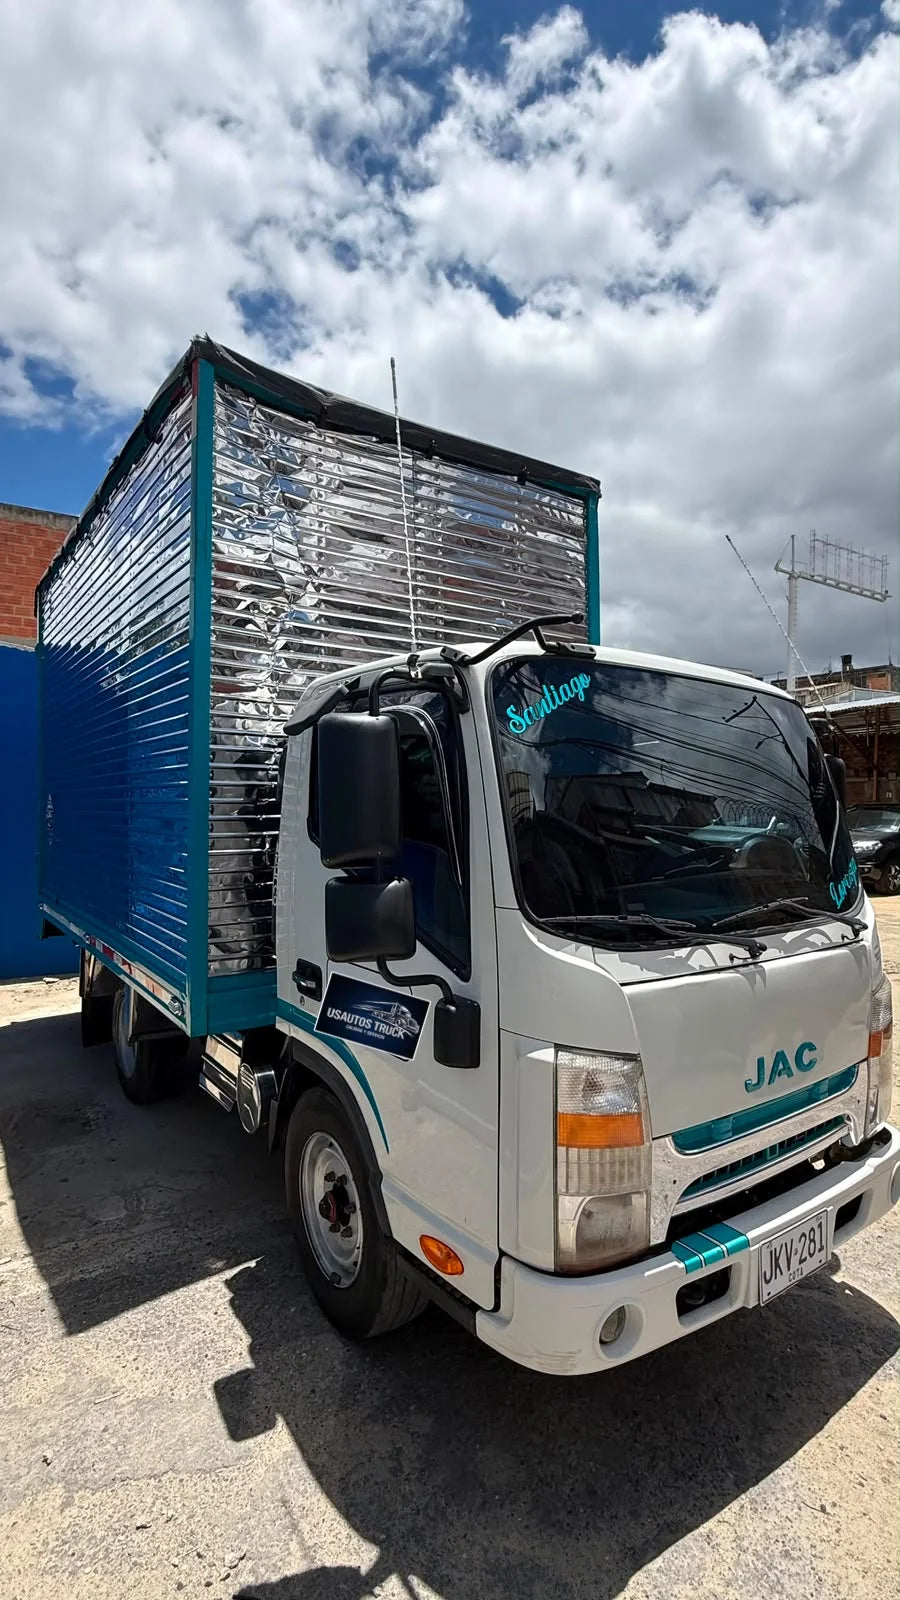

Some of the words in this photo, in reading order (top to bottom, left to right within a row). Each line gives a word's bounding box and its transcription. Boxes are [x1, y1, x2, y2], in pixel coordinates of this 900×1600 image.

[506, 672, 591, 734] Santiago
[326, 1007, 373, 1029] USAUTOS
[373, 1020, 405, 1040] TRUCK
[744, 1041, 818, 1093] JAC
